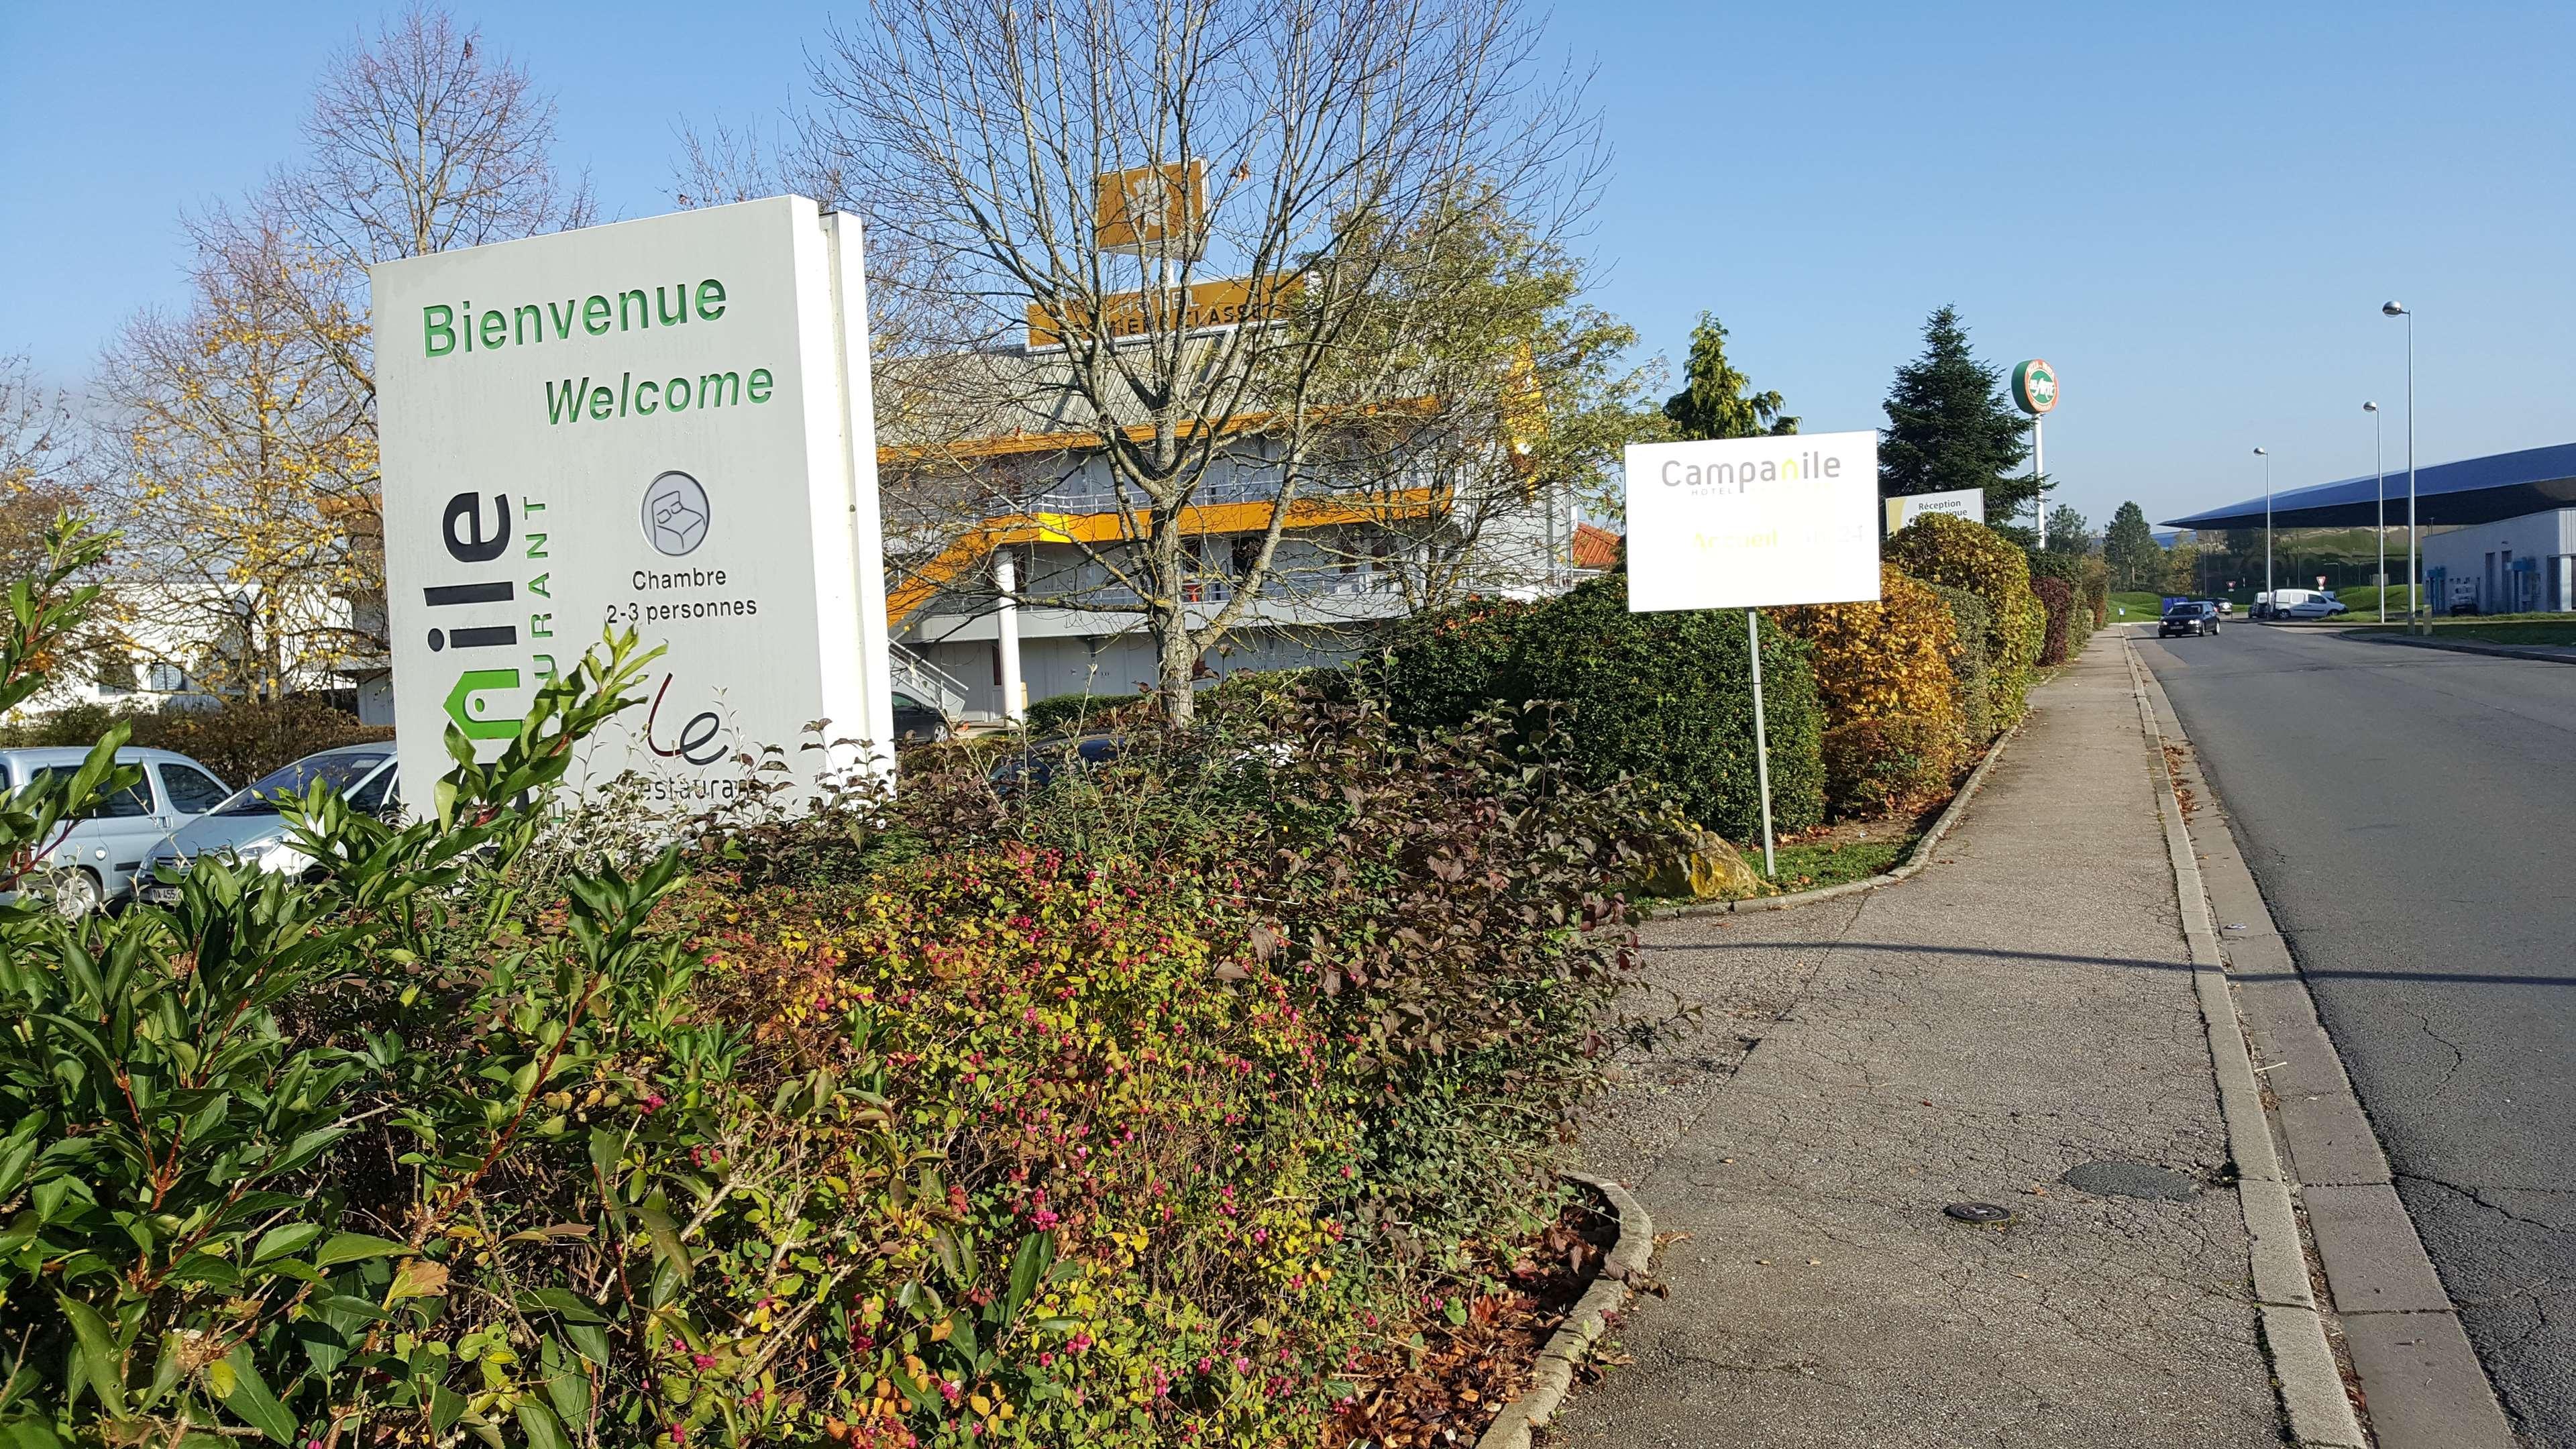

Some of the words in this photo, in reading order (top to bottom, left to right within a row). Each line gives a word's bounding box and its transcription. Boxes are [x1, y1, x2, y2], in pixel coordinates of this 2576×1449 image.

[423, 278, 727, 359] Bienvenue
[545, 368, 773, 425] Welcome
[1662, 451, 1841, 494] Campanile
[1691, 487, 1733, 496] HOTEL
[1919, 500, 1962, 511] Réception
[632, 567, 727, 591] Chambre
[606, 602, 639, 624] 2-3
[646, 599, 757, 625] personnes
